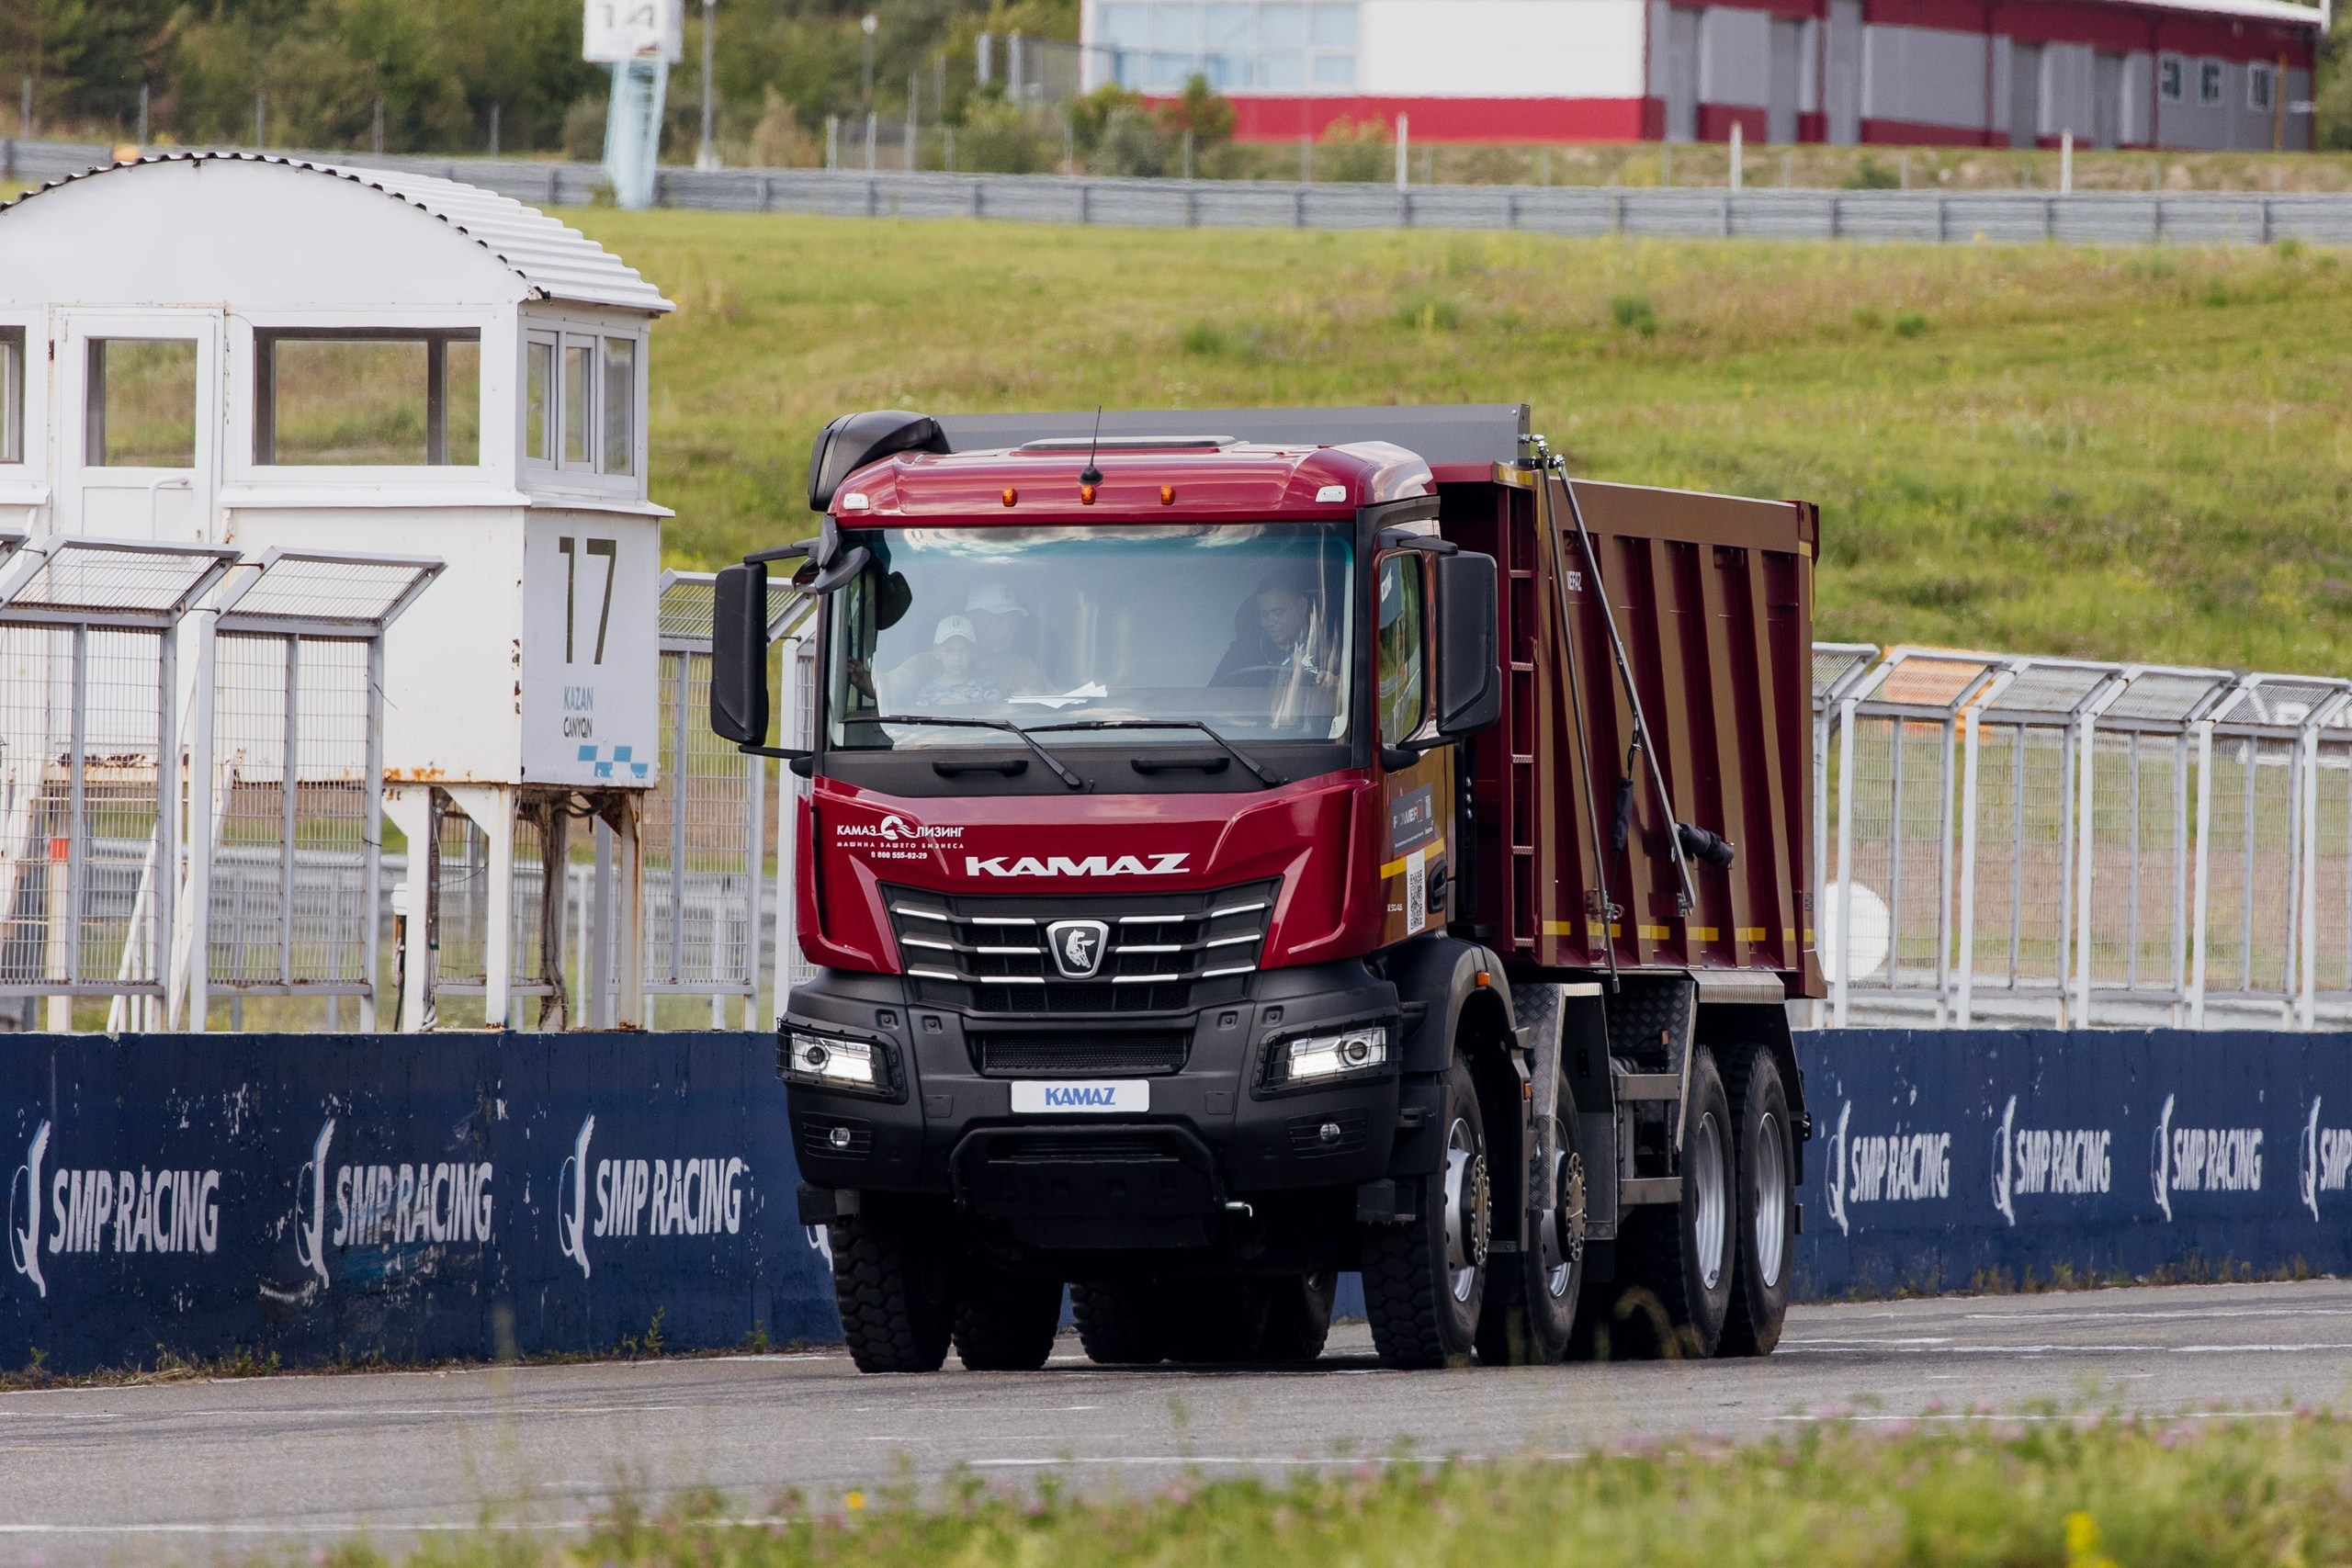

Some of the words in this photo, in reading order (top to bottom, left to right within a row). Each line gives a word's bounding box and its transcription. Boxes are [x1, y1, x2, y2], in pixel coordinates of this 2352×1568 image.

[600, 2, 655, 29] 14
[559, 536, 616, 665] 17
[563, 685, 594, 711] KAZAN
[563, 716, 593, 739] CANYON
[836, 825, 876, 836] КАМАЗ
[917, 827, 965, 838] ЛИЗИНГ
[876, 851, 891, 859] 800
[891, 852, 928, 860] 555-92-29
[965, 853, 1191, 877] KAMAZ
[1045, 1087, 1116, 1106] KAMAZ
[1849, 1136, 1887, 1203] SMP
[1886, 1132, 1951, 1201] RACING
[2015, 1129, 2051, 1194] SMP
[2051, 1129, 2111, 1193] RACING
[2172, 1128, 2206, 1190] SMP
[2205, 1128, 2263, 1190] RACING
[49, 1168, 113, 1253] SMP
[115, 1168, 220, 1253] RACING
[334, 1166, 395, 1247] SMP
[395, 1162, 492, 1243] RACING
[594, 1159, 650, 1237] SMP
[650, 1156, 742, 1235] RACING
